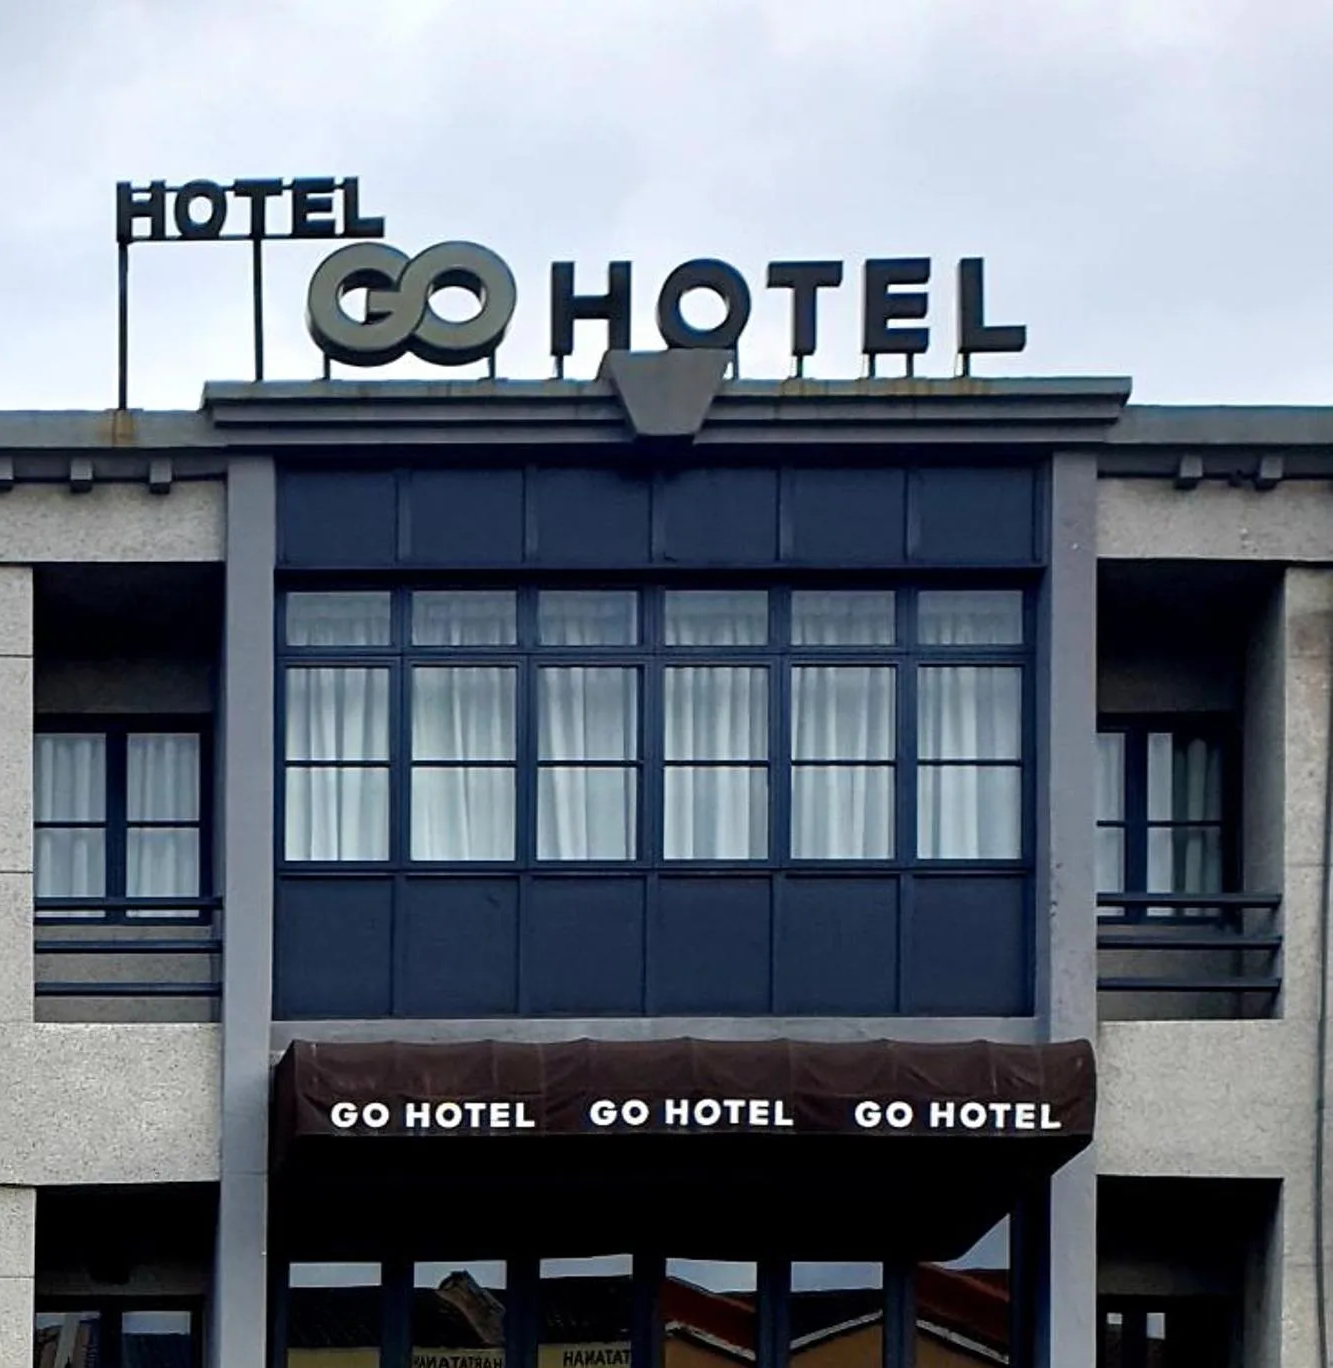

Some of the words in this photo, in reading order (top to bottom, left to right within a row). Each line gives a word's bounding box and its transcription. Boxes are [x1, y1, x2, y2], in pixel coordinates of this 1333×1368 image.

[116, 177, 385, 240] HOTEL
[307, 240, 517, 366] GO
[551, 257, 1027, 355] HOTEL
[330, 1102, 390, 1128] GO
[405, 1102, 536, 1129] HOTEL
[589, 1099, 650, 1126] GO
[665, 1098, 794, 1126] HOTEL
[854, 1100, 913, 1128] GO
[930, 1101, 1062, 1130] HOTEL
